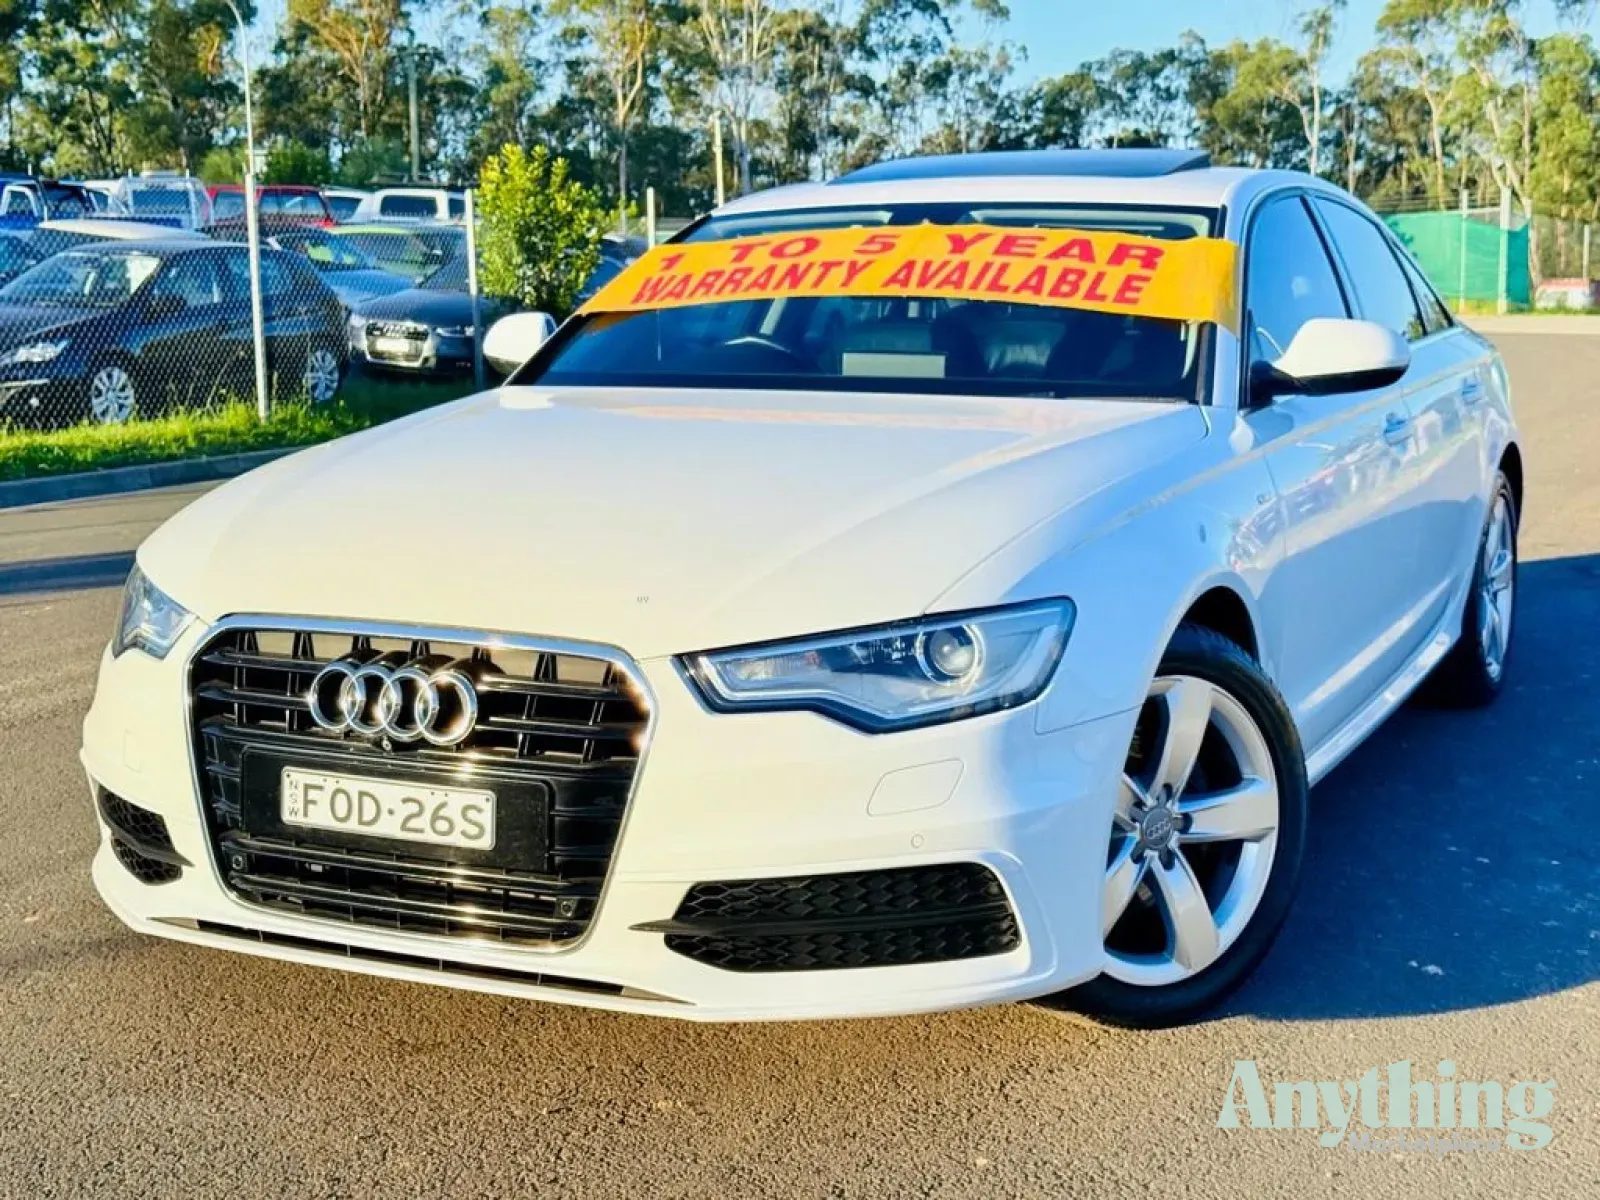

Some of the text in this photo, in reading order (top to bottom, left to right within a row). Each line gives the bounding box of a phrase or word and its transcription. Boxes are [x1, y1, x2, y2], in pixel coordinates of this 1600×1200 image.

[659, 232, 1166, 271] 1 TO 5 YEAR
[631, 259, 1152, 306] WARRANTY AVAILABLE
